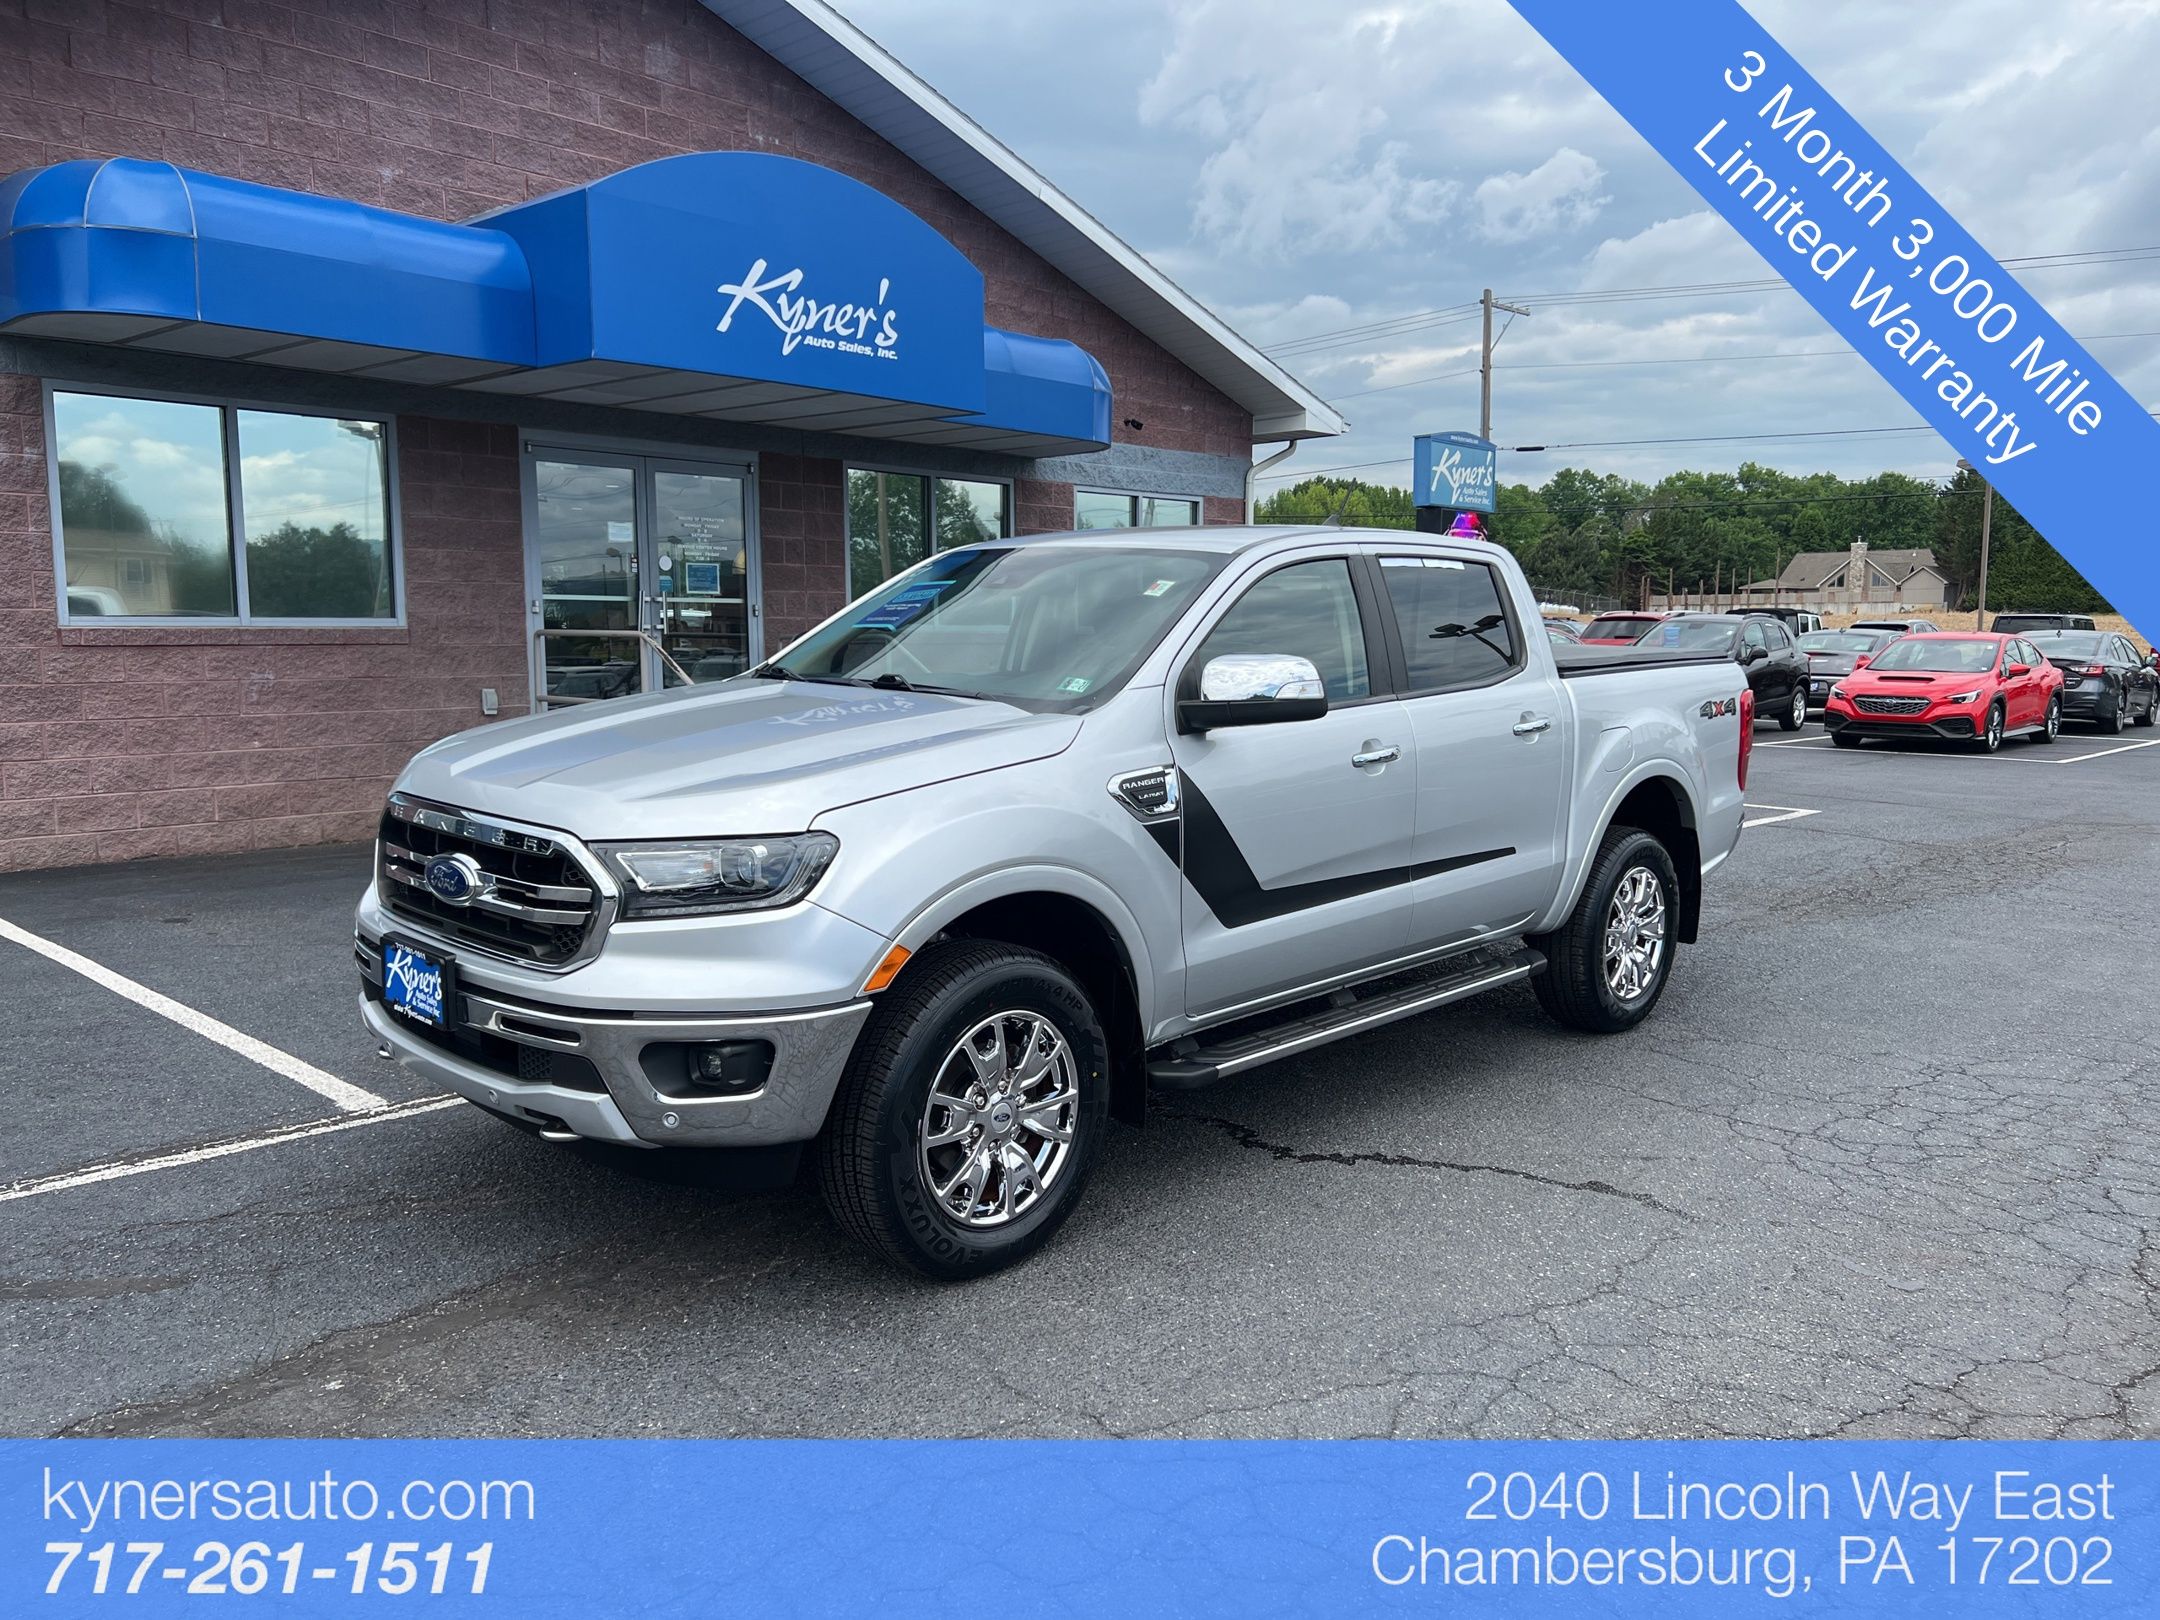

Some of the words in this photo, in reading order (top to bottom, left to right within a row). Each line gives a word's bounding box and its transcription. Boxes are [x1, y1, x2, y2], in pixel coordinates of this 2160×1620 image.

[716, 258, 898, 356] Kyner's
[803, 335, 836, 350] Auto
[838, 341, 874, 357] Sales,
[877, 347, 898, 360] Inc.
[1431, 447, 1493, 505] Kyner's
[1122, 776, 1165, 790] RANGER
[1138, 791, 1165, 800] LARIAT
[431, 864, 459, 892] Ford
[386, 948, 442, 1002] Kyner's
